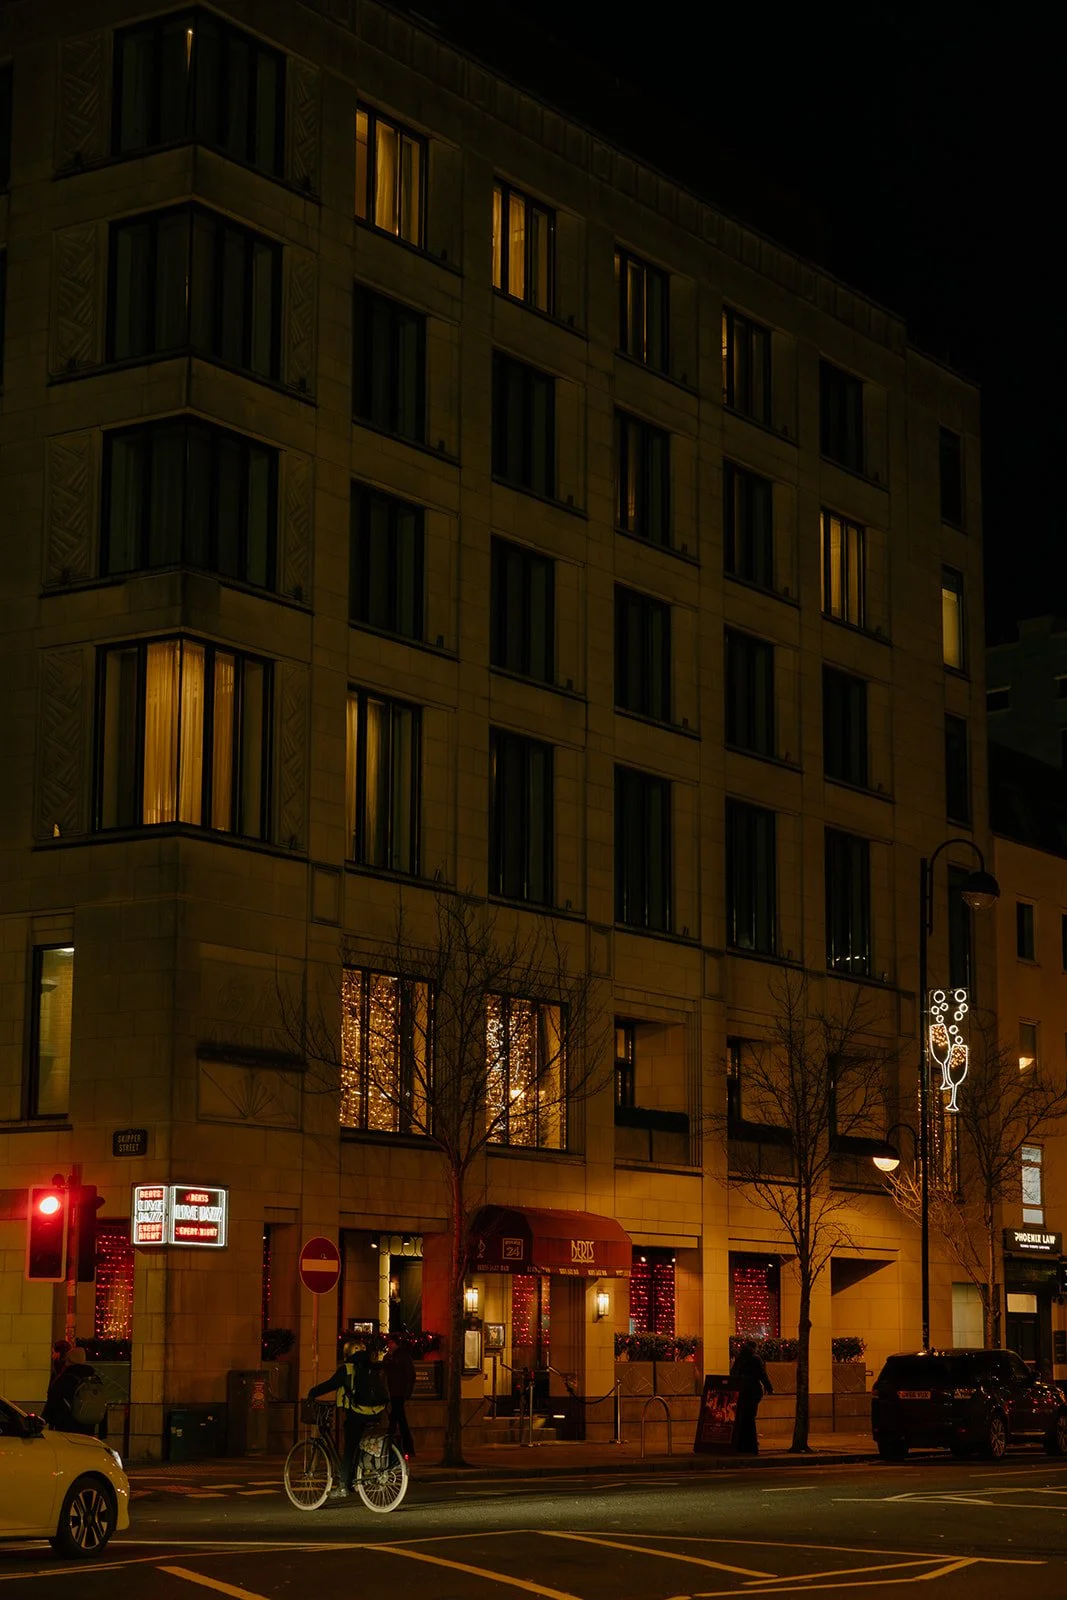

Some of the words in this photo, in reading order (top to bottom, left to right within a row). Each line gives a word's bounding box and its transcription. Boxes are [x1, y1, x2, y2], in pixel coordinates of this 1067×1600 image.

[117, 1134, 142, 1144] SKIPPER
[118, 1143, 140, 1153] STREET
[139, 1189, 163, 1199] BERTS
[189, 1193, 209, 1203] BERTS
[137, 1199, 164, 1212] LIVE
[135, 1211, 163, 1224] JAZZ
[175, 1204, 199, 1221] LIVE
[199, 1205, 223, 1222] JAZZ
[138, 1224, 162, 1232] EVERY
[178, 1226, 198, 1236] EVERY
[198, 1227, 218, 1237] NIGHT
[138, 1231, 161, 1240] NIGHT
[1013, 1231, 1042, 1244] PHOENIX
[1042, 1234, 1056, 1245] LAW
[571, 1239, 595, 1261] BERTS
